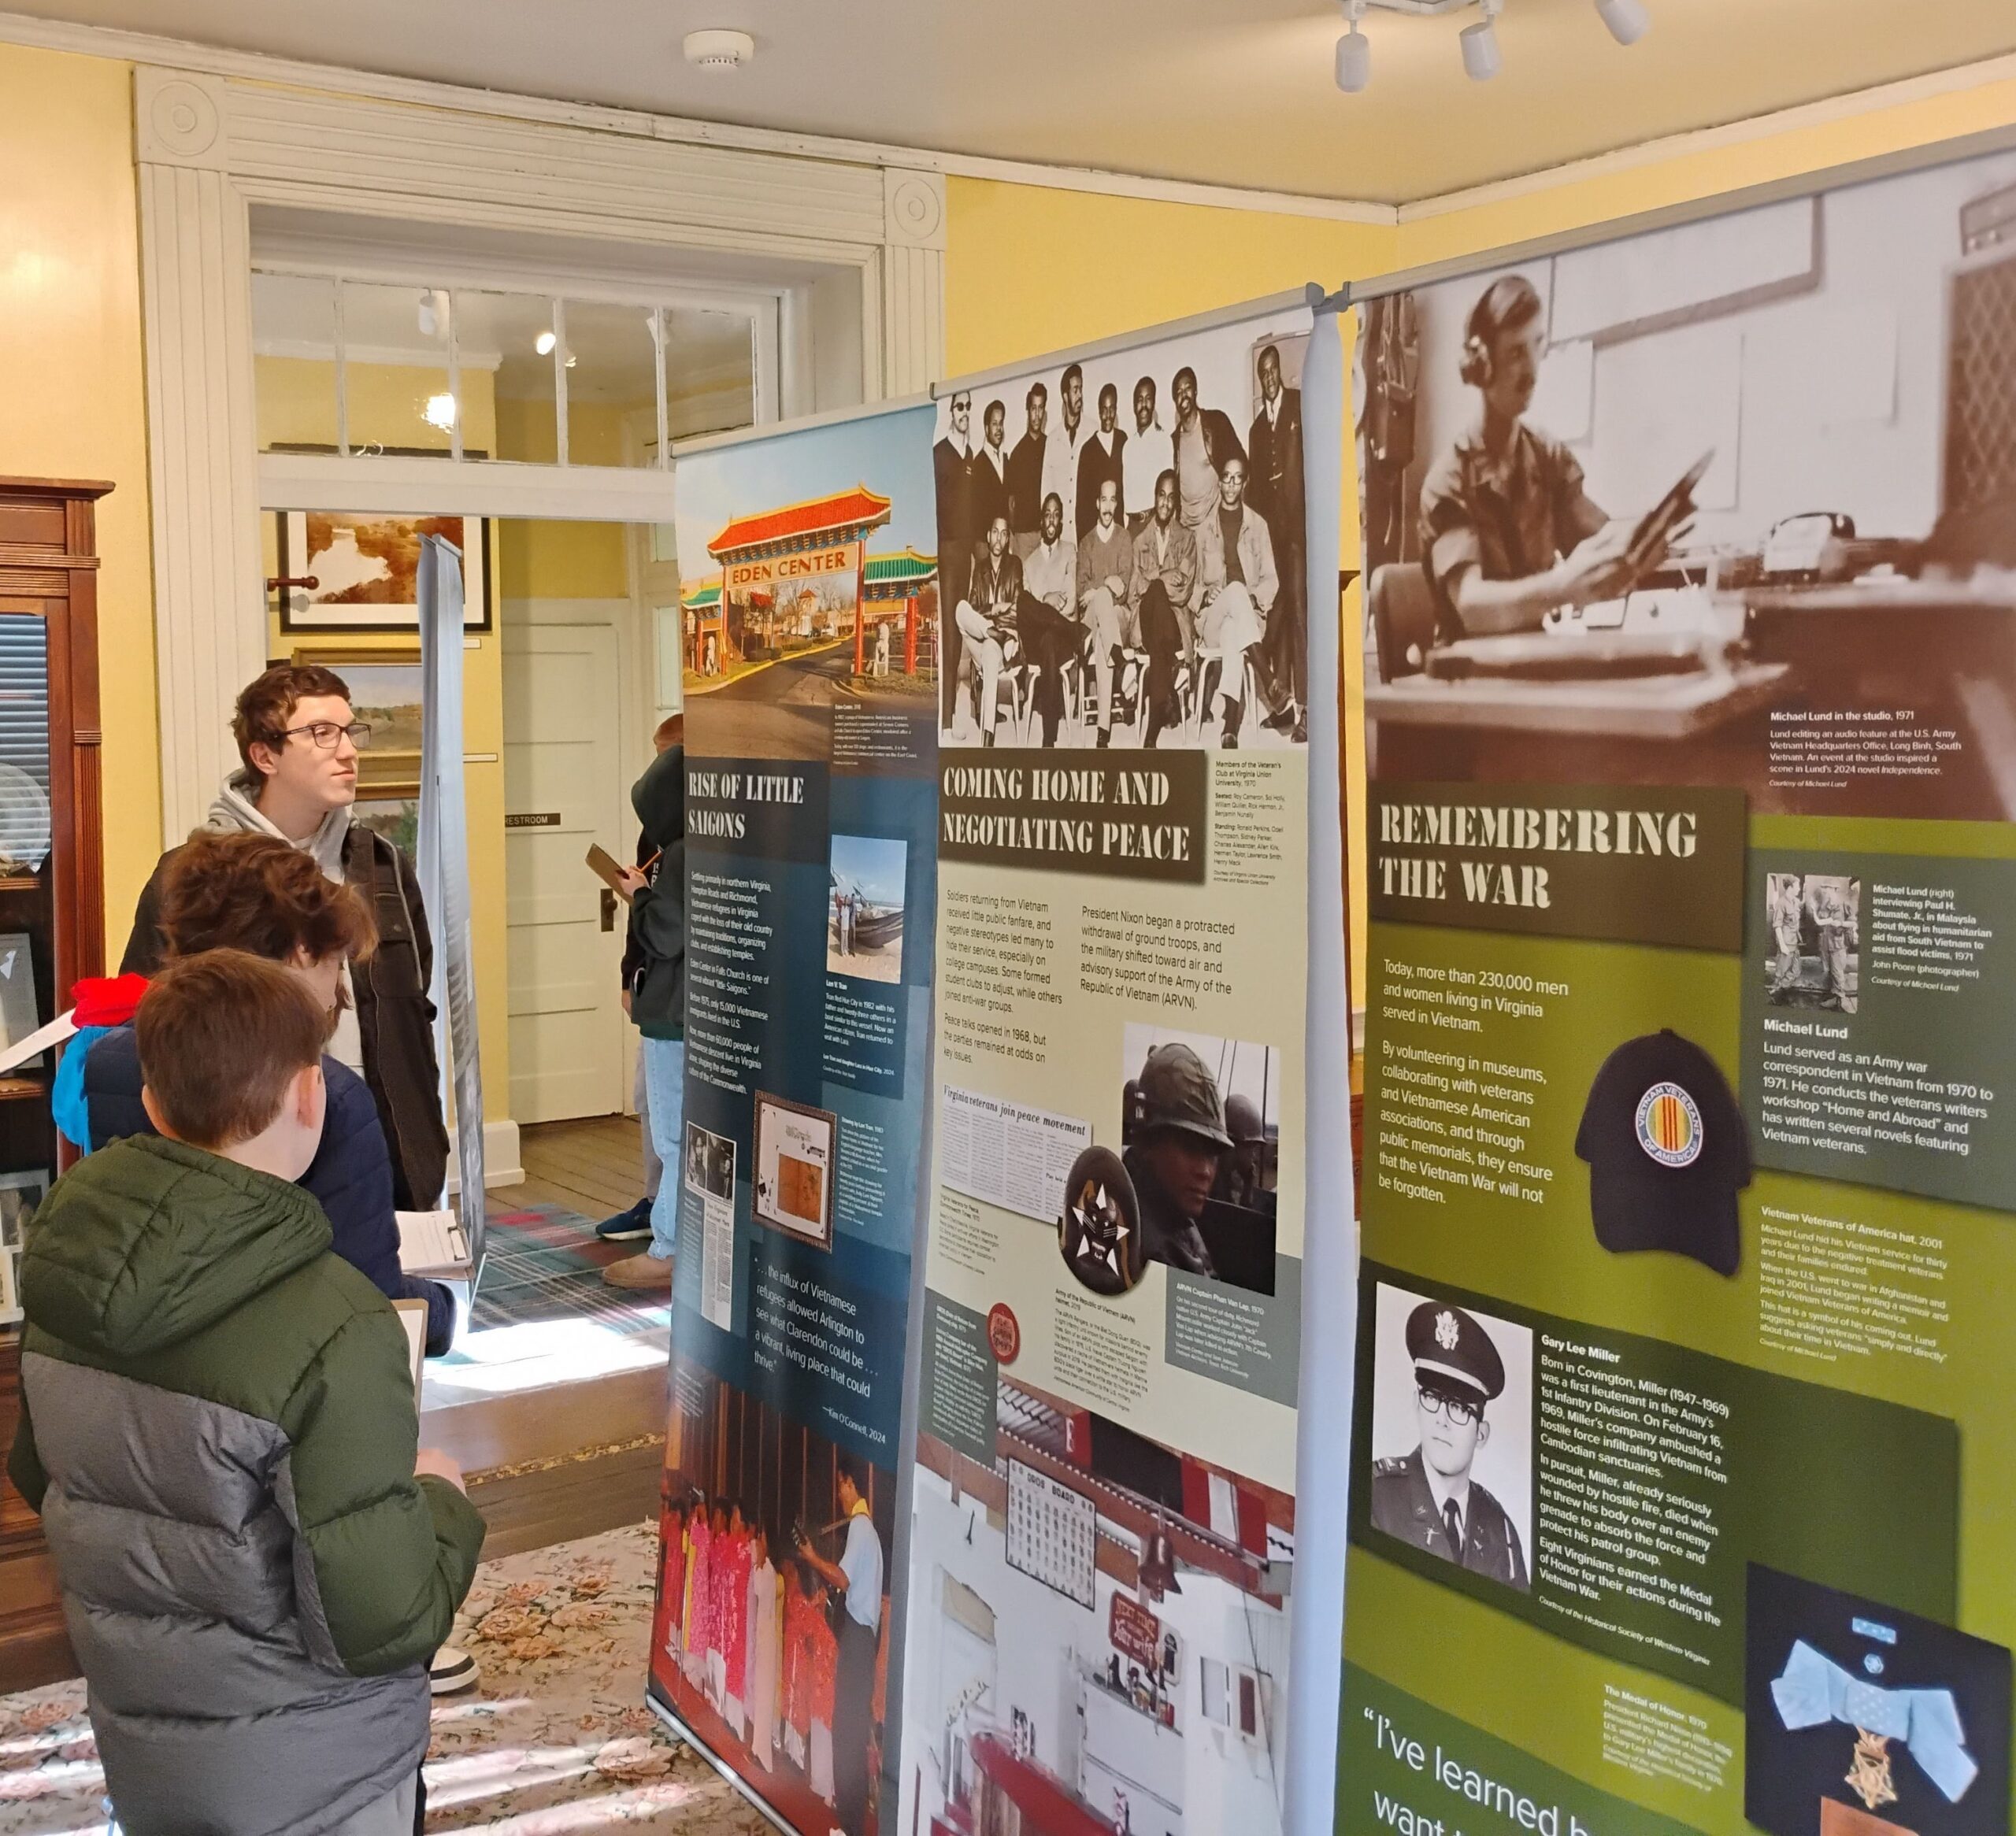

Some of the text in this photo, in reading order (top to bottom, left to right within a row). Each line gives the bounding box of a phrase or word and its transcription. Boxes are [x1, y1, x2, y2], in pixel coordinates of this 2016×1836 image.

[732, 551, 845, 584] EDEN CENTER
[1770, 710, 1914, 721] Michael Lund in the studio, 1971
[689, 772, 803, 803] RISE OF LITTLE
[943, 768, 1169, 805] COMING HOME AND
[688, 810, 744, 838] SAIGONS
[943, 813, 1189, 861] NEGOTIATING PEACE
[1380, 805, 1696, 857] REMEMBERING
[1379, 857, 1551, 909] THE WAR
[1081, 925, 1221, 953] withdrawal of ground troops, and
[1082, 905, 1235, 935] President Nixon began a protracted
[1080, 942, 1222, 973] the military shifted toward air and
[1384, 958, 1568, 995] Today, more than 230,000 men
[1080, 961, 1232, 994] advisory support of the Army of the
[1080, 978, 1197, 1012] Republic of Vietnam (ARVN).
[1383, 983, 1543, 1017] and women living in Virginia
[1383, 1006, 1484, 1033] served in Vietnam.
[1764, 1019, 1847, 1038] Michael Lund
[1382, 1039, 1547, 1085] By volunteering in museums,
[1763, 1041, 1928, 1072] Lund served as an Army war
[1381, 1064, 1534, 1105] collaborating with veterans
[1762, 1061, 1993, 1100] correspondent in Vietnam from 1970 to
[943, 1084, 1085, 1135] Virginia veterans join peace movement
[1380, 1087, 1530, 1127] and Vietnamese American
[1638, 1086, 1699, 1135] VIETNAM VETERANS
[1380, 1109, 1525, 1152] associations, and through
[1380, 1131, 1553, 1181] public memorials, they ensure
[1644, 1138, 1696, 1163] OF AMERICA
[1378, 1173, 1447, 1204] be forgotten.
[1379, 1151, 1544, 1204] that the Vietnam War will not
[1761, 1205, 1799, 1222] Vietnam
[1801, 1213, 1844, 1229] Veterans
[1845, 1223, 1856, 1231] of
[1857, 1223, 1897, 1239] America
[1918, 1235, 1942, 1249] 2001
[768, 1265, 856, 1316] the influx of Vietnamese
[757, 1284, 865, 1344] refugees allowed Arlington to
[756, 1307, 863, 1369] see what Clarendon could be
[1541, 1334, 1621, 1363] Gary Lee Miller
[754, 1330, 870, 1397] a vibrant, living place that could
[1436, 1745, 1558, 1836] learned
